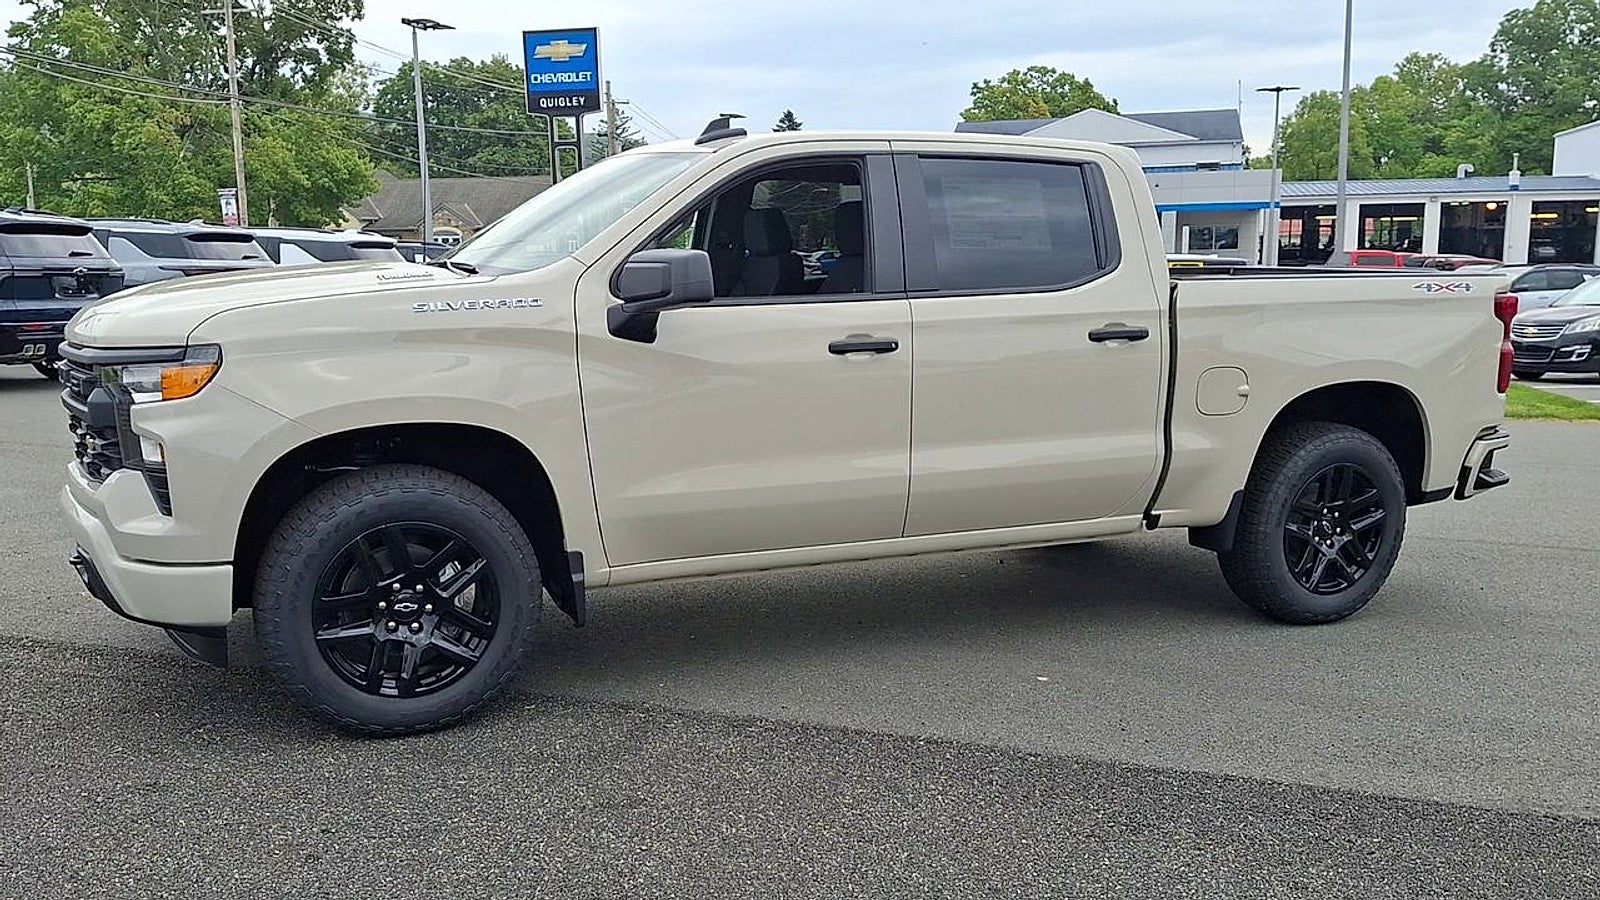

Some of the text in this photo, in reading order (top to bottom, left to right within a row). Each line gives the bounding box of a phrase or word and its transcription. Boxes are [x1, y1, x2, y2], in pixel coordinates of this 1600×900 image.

[531, 72, 592, 84] CHEVROLET
[540, 97, 586, 108] QUIGLEY
[412, 297, 543, 313] SILVERADO
